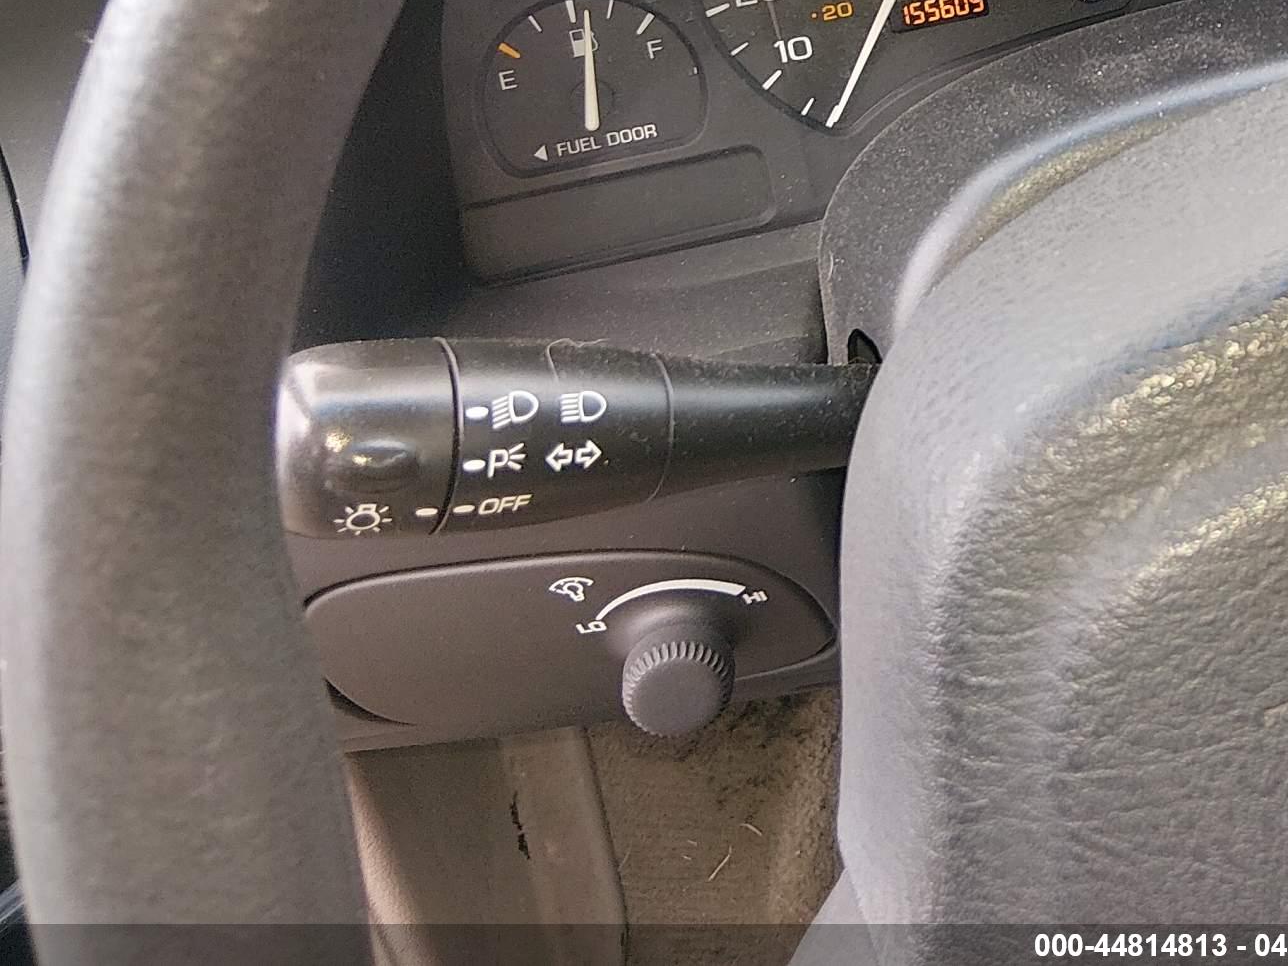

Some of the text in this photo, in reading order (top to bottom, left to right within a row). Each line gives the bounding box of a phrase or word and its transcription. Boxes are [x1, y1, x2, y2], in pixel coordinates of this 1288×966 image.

[821, 1, 852, 21] 20
[647, 39, 663, 59] F
[774, 36, 813, 62] 10
[499, 70, 518, 90] E
[556, 124, 658, 157] FUEL DOOR
[478, 493, 534, 514] OFF
[741, 590, 769, 605] HI
[575, 620, 607, 634] LO
